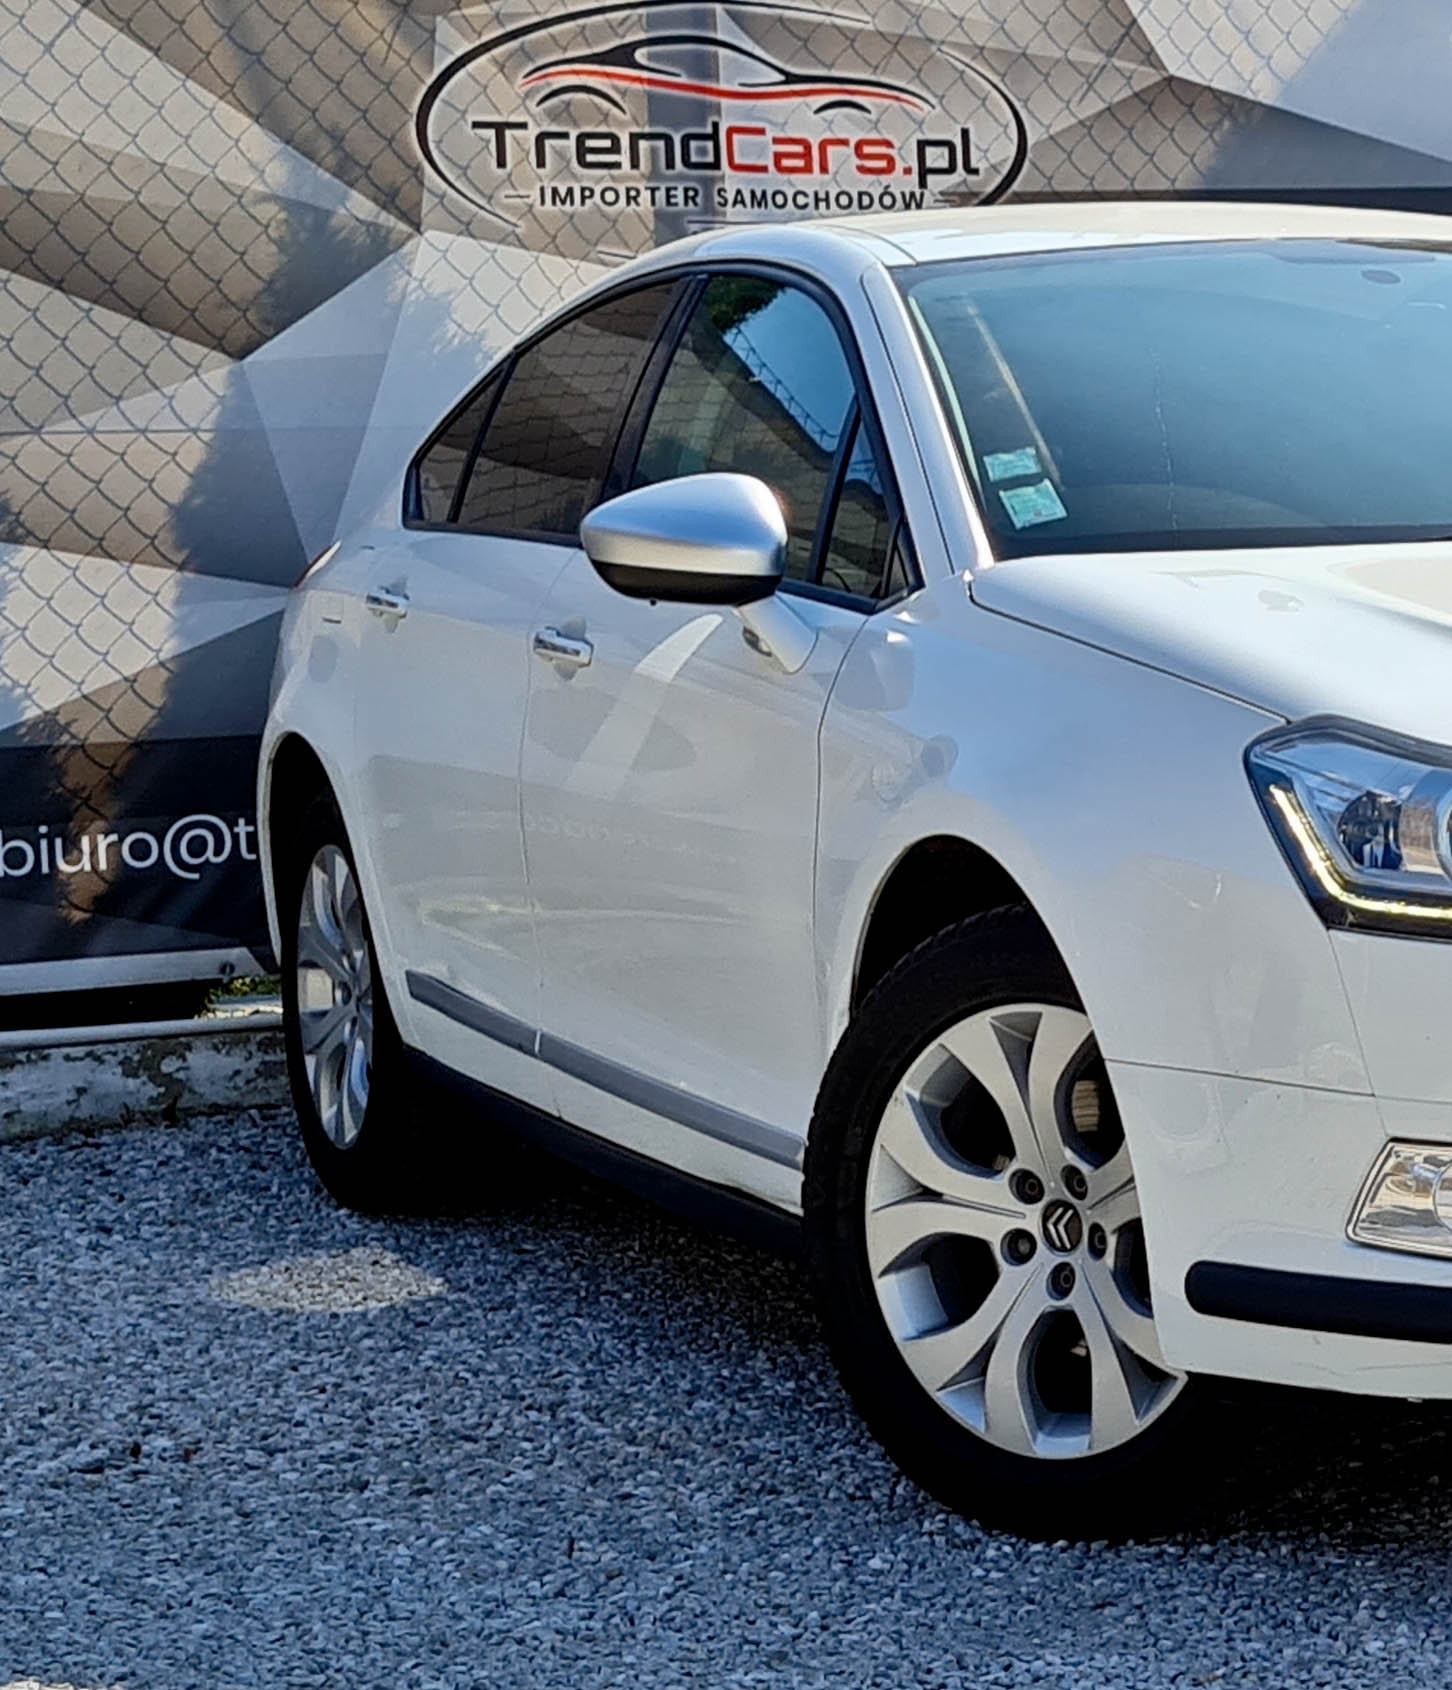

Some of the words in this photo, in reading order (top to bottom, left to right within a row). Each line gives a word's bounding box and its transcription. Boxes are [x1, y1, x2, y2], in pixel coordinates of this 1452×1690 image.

[470, 120, 980, 190] TrendCars.pl
[539, 185, 700, 208] IMPORTER
[716, 184, 926, 211] SAMOCHODÓW
[0, 813, 258, 881] biuro@t
